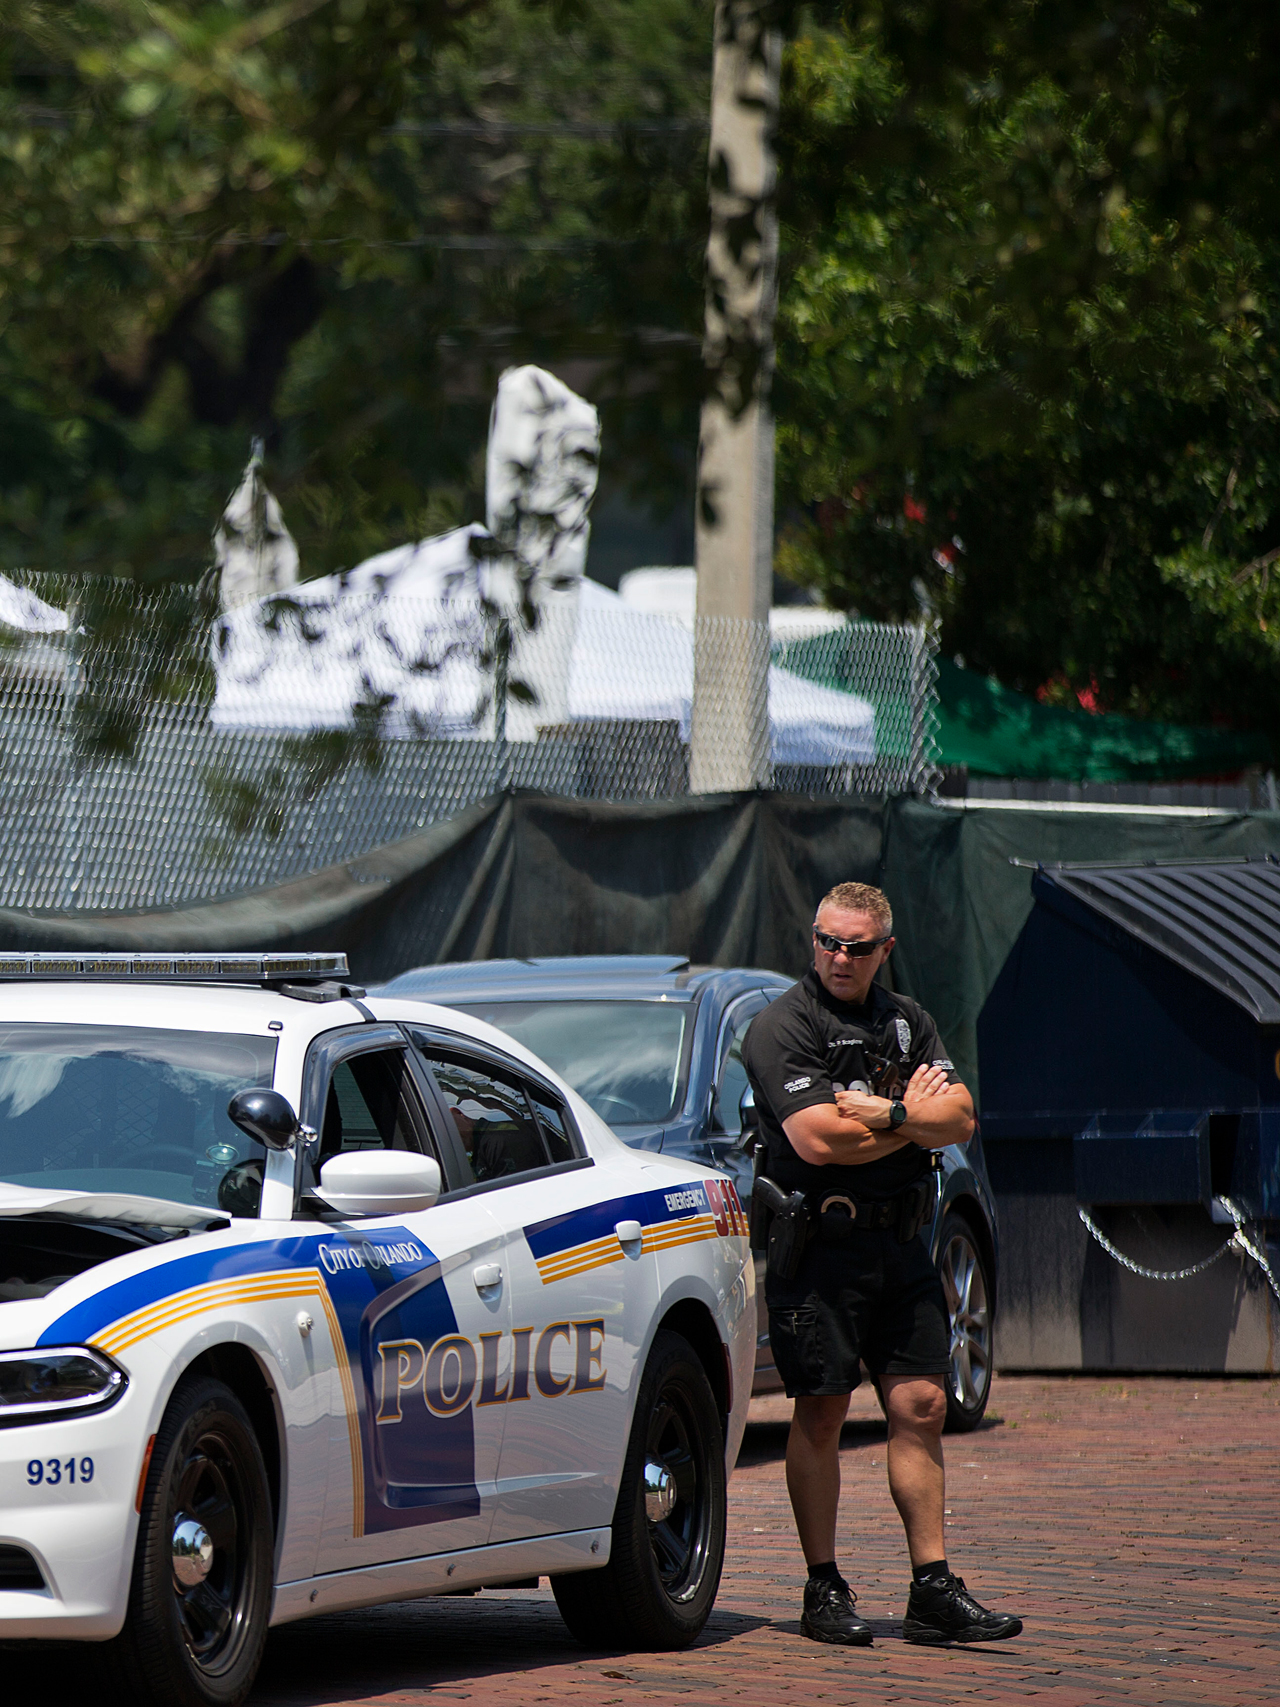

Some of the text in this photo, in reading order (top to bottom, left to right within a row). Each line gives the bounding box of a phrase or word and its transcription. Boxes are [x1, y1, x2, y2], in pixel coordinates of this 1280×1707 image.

[783, 1076, 811, 1090] ORLANDO
[788, 1082, 810, 1094] POLICE
[664, 1179, 747, 1237] EMERGENCY 911
[376, 1318, 608, 1425] POLICE
[26, 1456, 95, 1486] 9319
